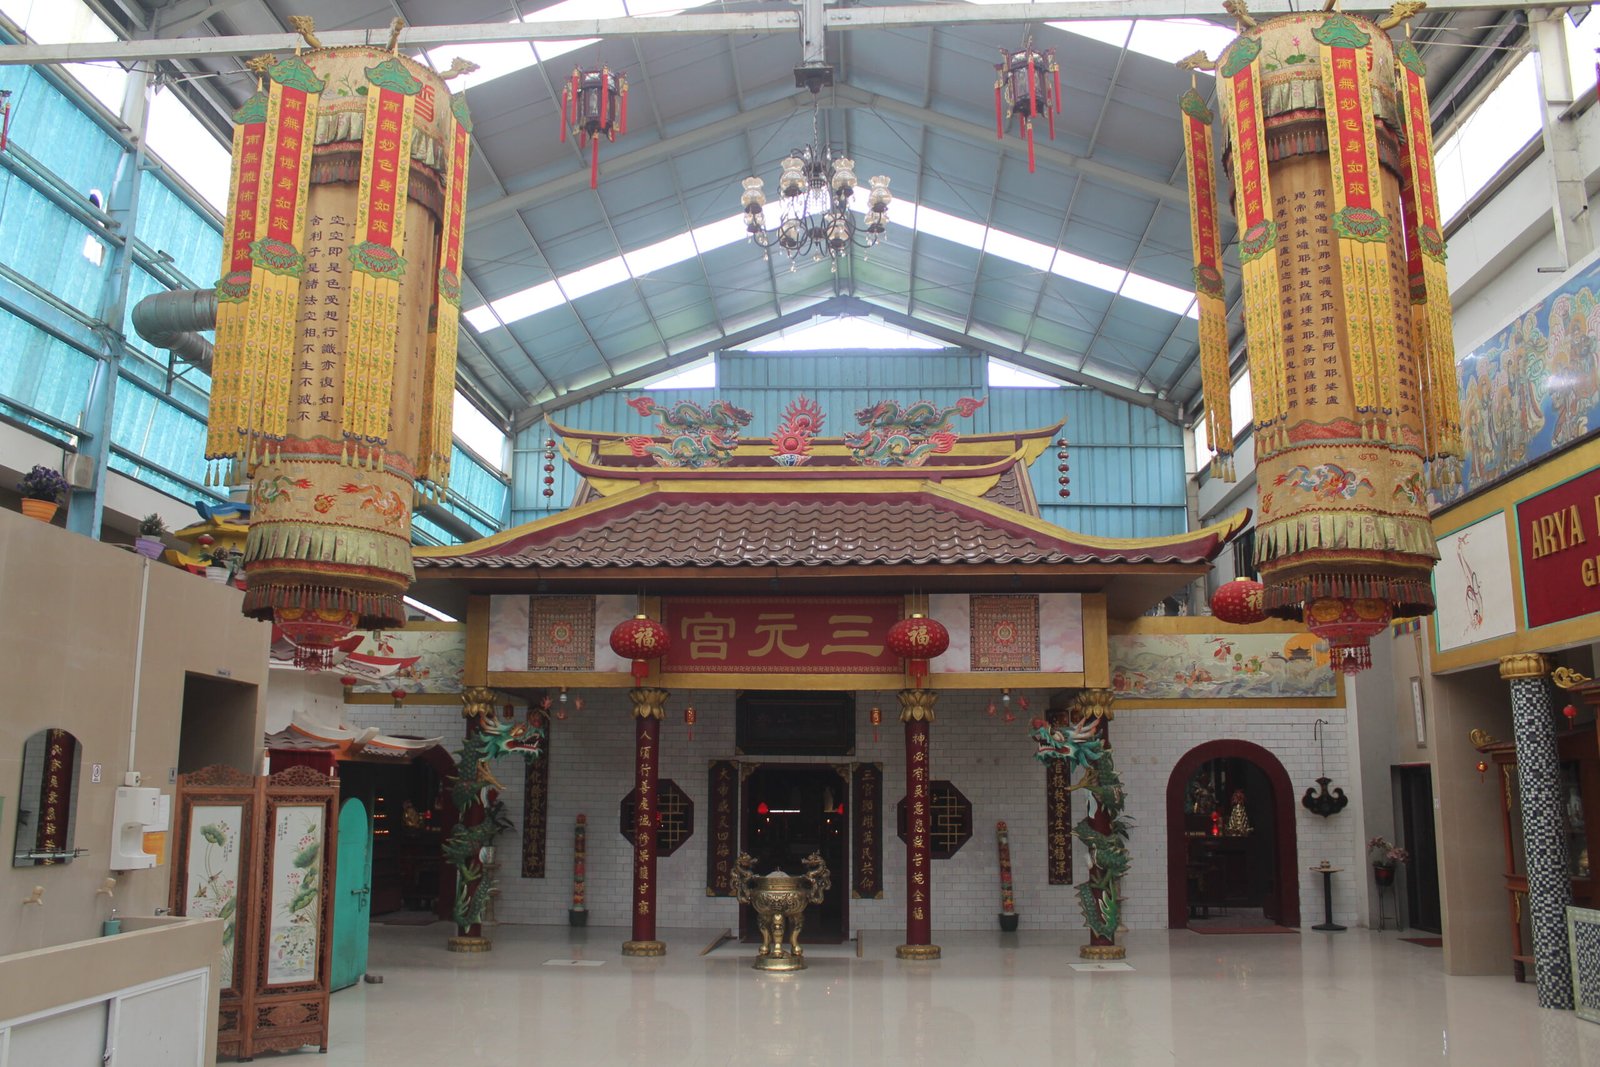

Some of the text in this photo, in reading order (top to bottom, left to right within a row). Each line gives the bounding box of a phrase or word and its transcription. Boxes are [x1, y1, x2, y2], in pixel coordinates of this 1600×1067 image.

[272, 97, 300, 232] 南無廣博身如來
[372, 97, 400, 233] 南無妙色身如來
[1236, 77, 1260, 217] 南無廣博身如來
[1336, 57, 1366, 196] 南無妙色身如來
[1531, 504, 1587, 560] ARYA
[634, 627, 659, 648] 福
[907, 625, 931, 646] 福
